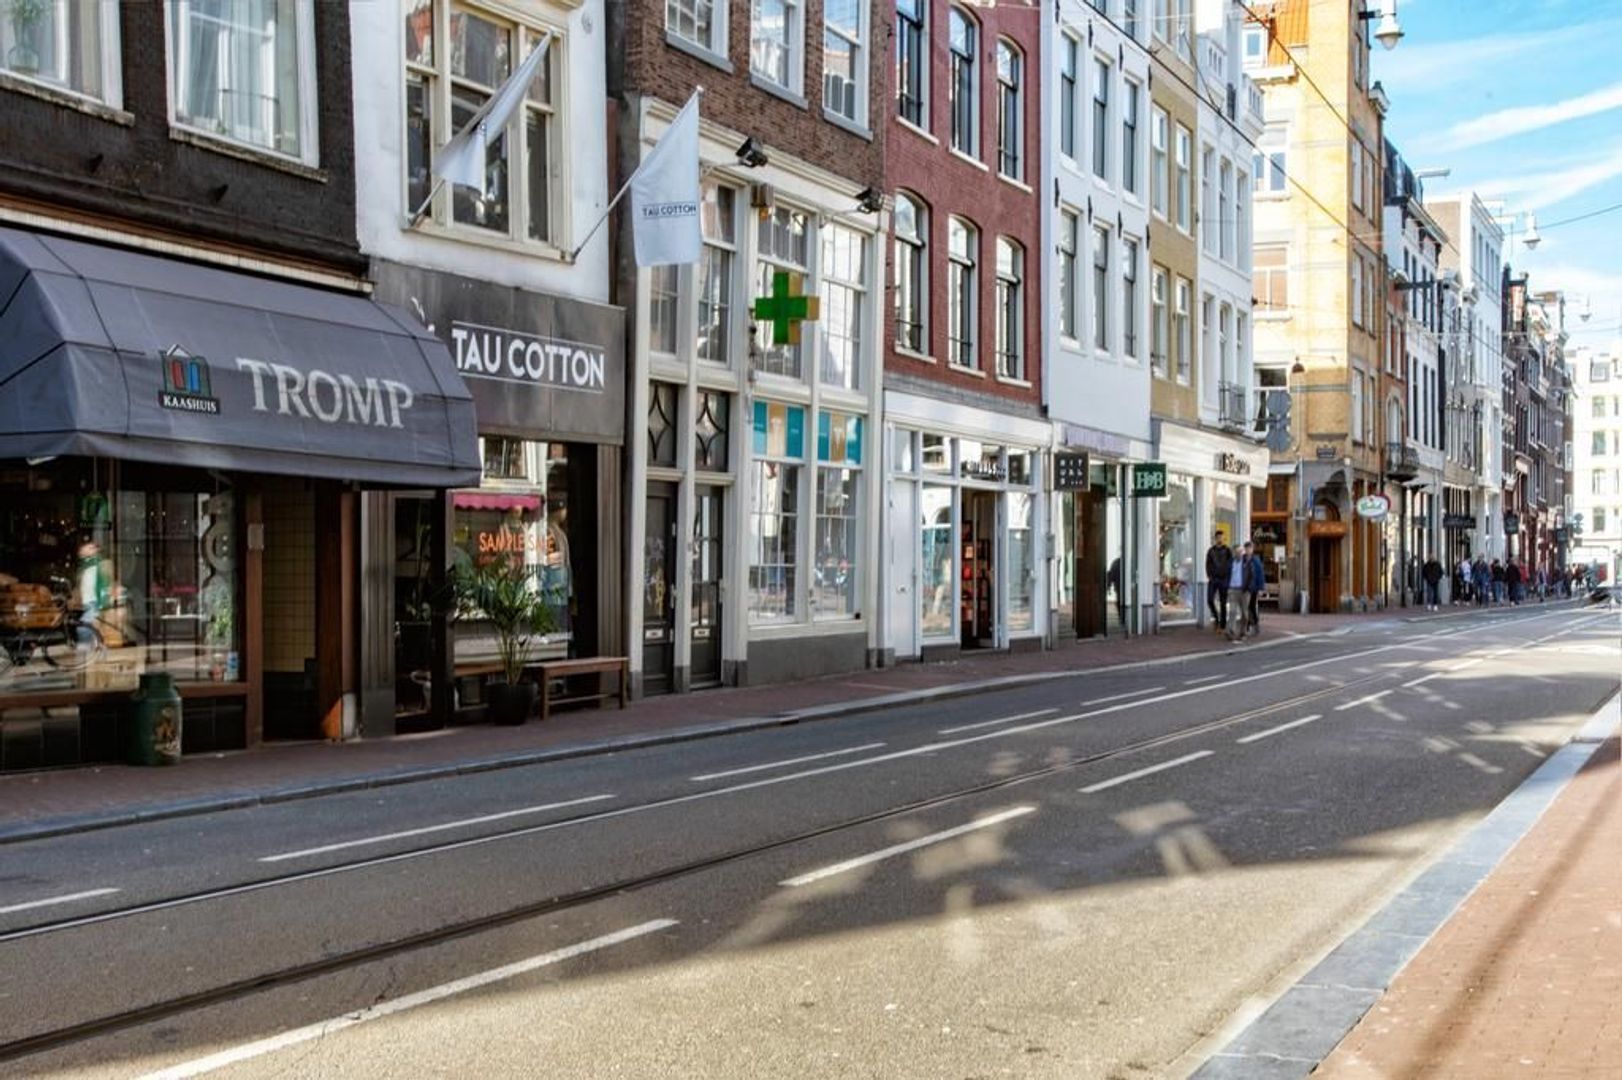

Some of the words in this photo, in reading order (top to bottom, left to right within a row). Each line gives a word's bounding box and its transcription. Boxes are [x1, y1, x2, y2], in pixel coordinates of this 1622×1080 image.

[642, 207, 660, 217] TAU
[661, 204, 697, 215] COTTON
[452, 329, 501, 374] TAU
[508, 338, 605, 388] COTTON
[163, 394, 217, 414] KAASHUIS
[235, 357, 414, 429] TROMP
[479, 531, 524, 553] SAMPLE
